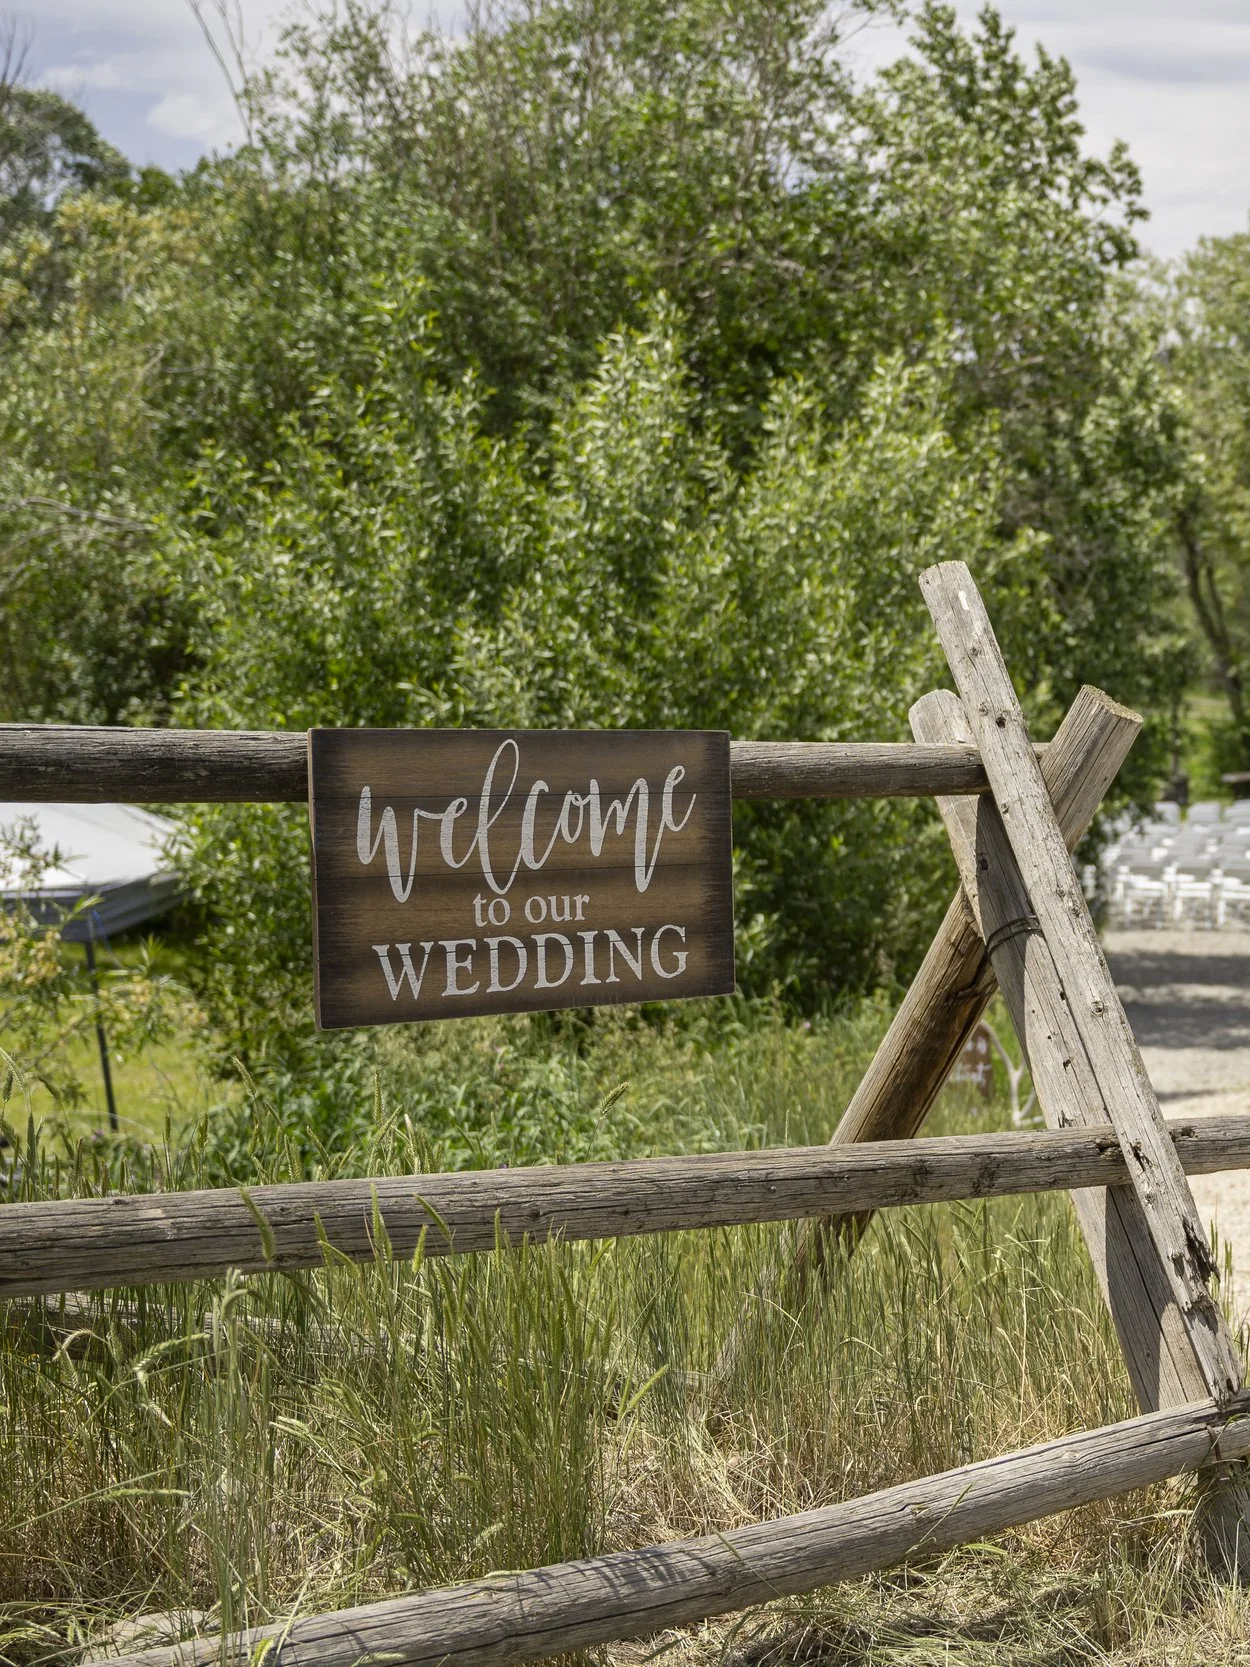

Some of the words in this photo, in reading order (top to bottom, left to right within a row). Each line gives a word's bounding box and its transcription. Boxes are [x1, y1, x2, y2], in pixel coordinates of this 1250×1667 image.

[472, 893, 511, 927] to
[525, 893, 590, 924] our
[372, 924, 690, 1001] WEDDING
